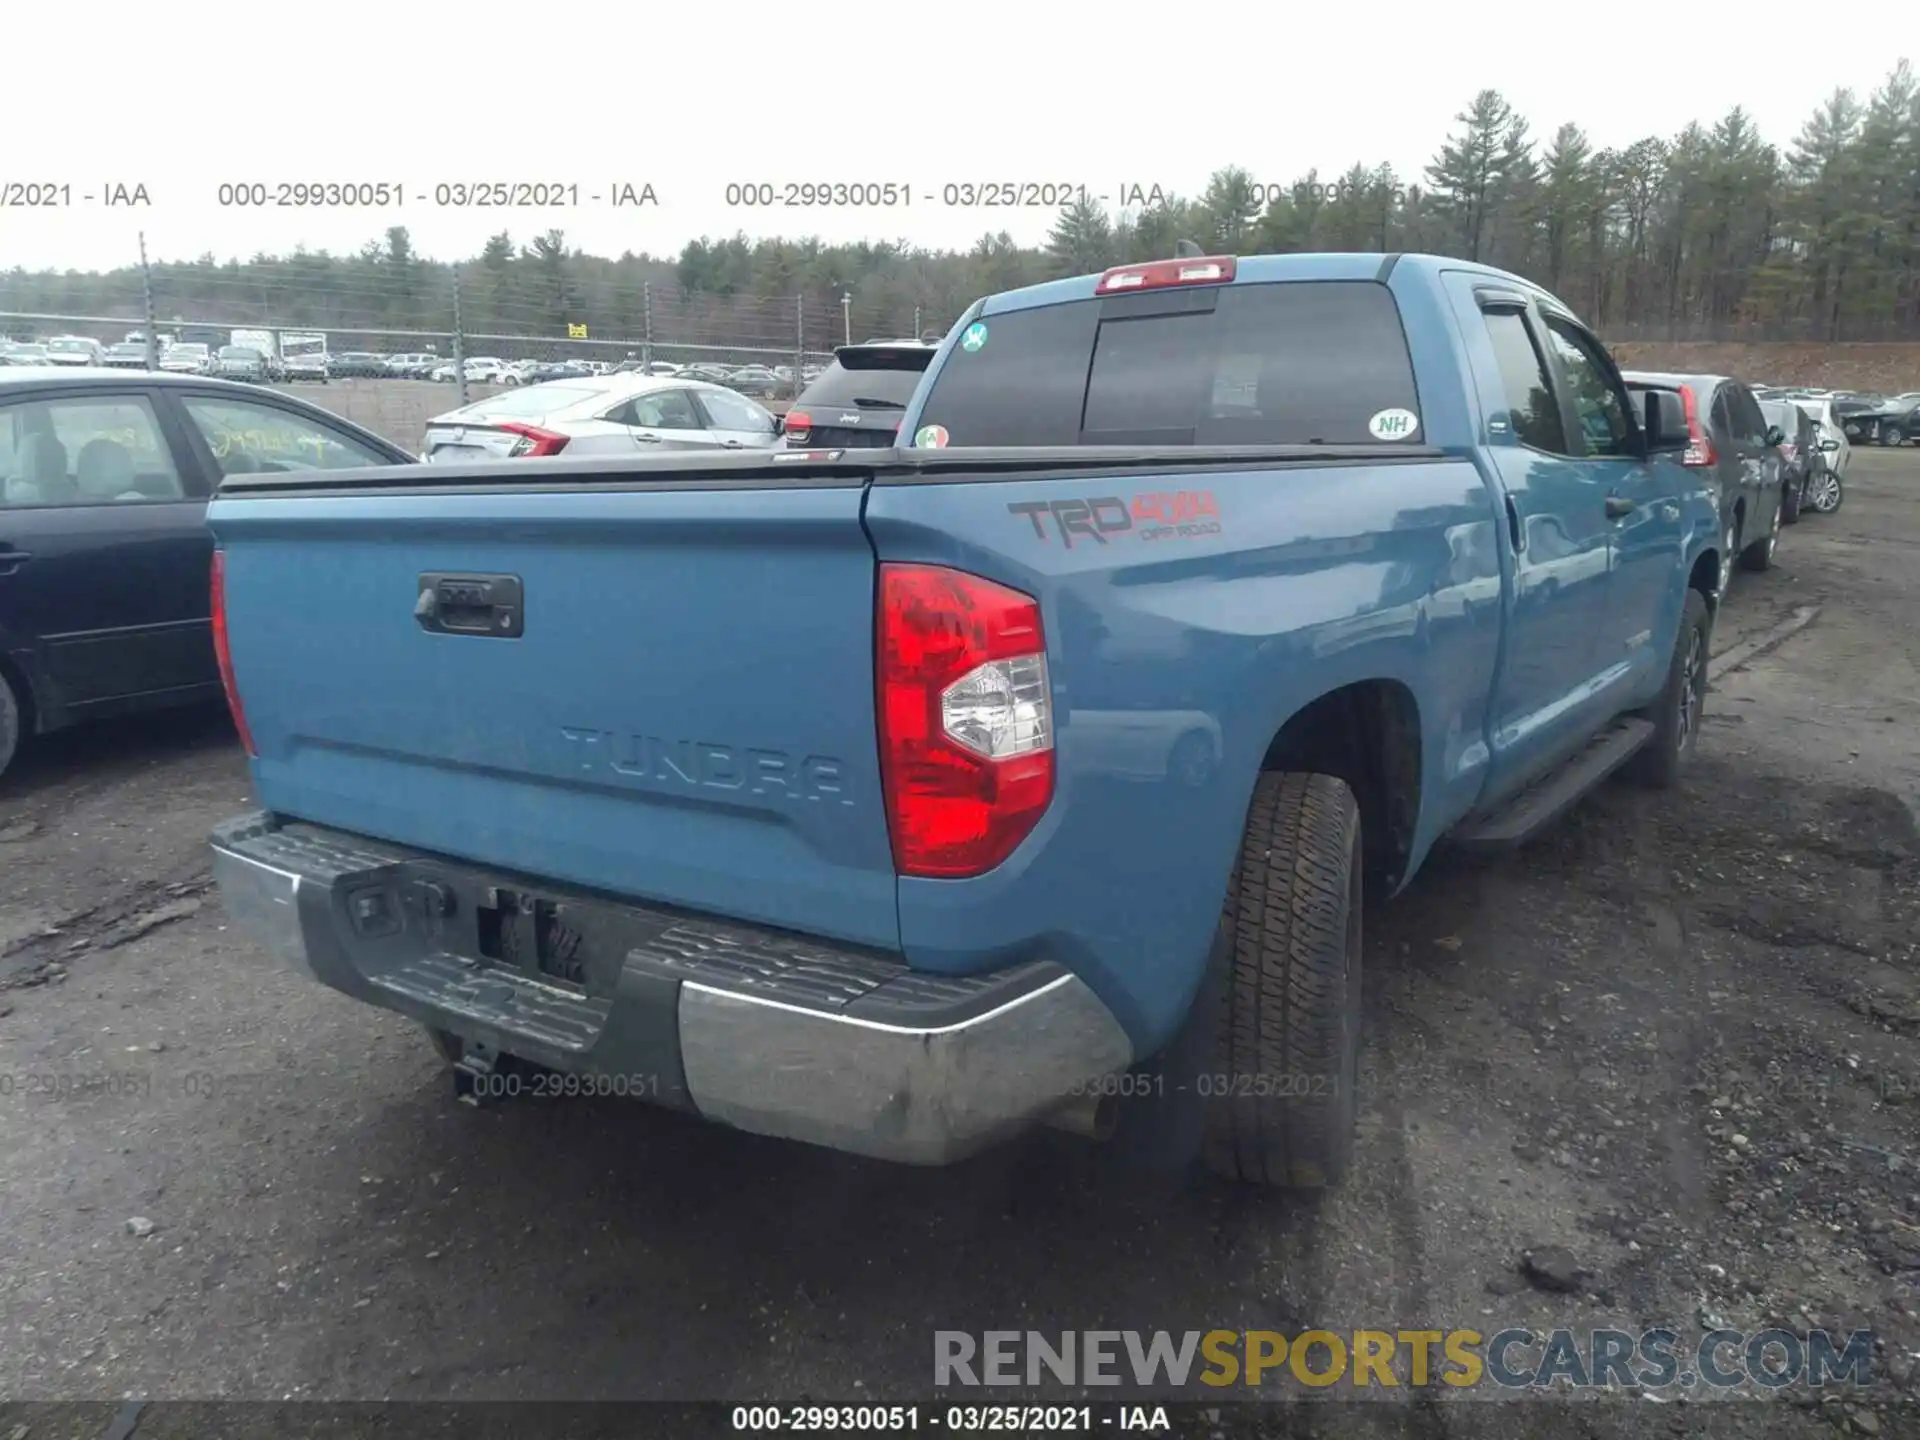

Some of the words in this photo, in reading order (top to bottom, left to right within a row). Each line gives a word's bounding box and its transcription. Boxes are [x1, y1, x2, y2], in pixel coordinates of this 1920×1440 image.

[1378, 415, 1409, 432] NH
[1006, 496, 1133, 550] TRD
[560, 727, 855, 806] TUNDRA
